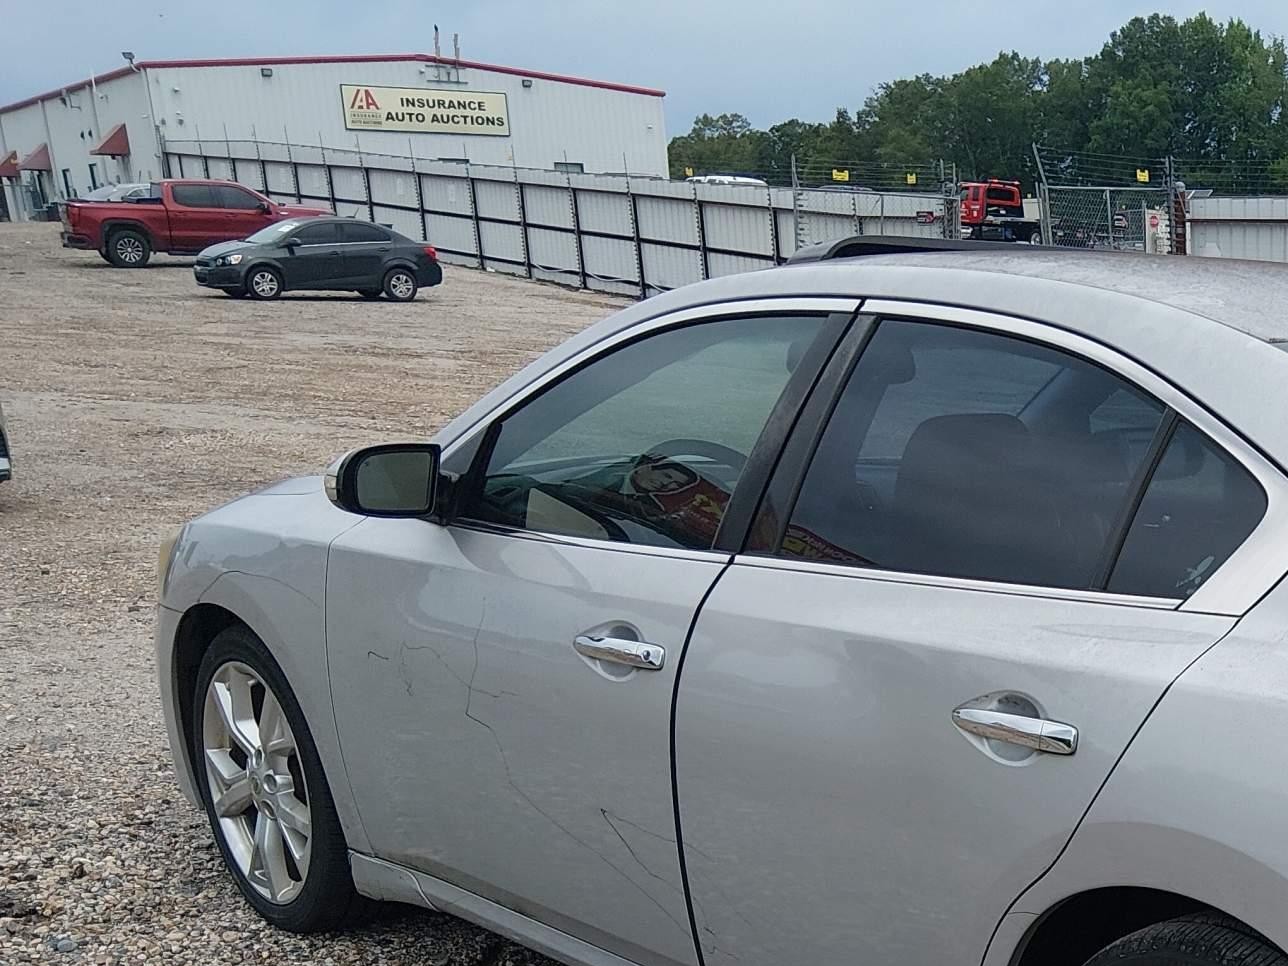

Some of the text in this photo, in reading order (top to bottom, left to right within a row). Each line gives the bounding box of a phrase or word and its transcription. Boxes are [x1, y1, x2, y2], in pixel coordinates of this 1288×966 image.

[400, 97, 486, 111] INSURANCE
[385, 112, 425, 123] AUTO
[431, 114, 504, 127] AUCTIONS
